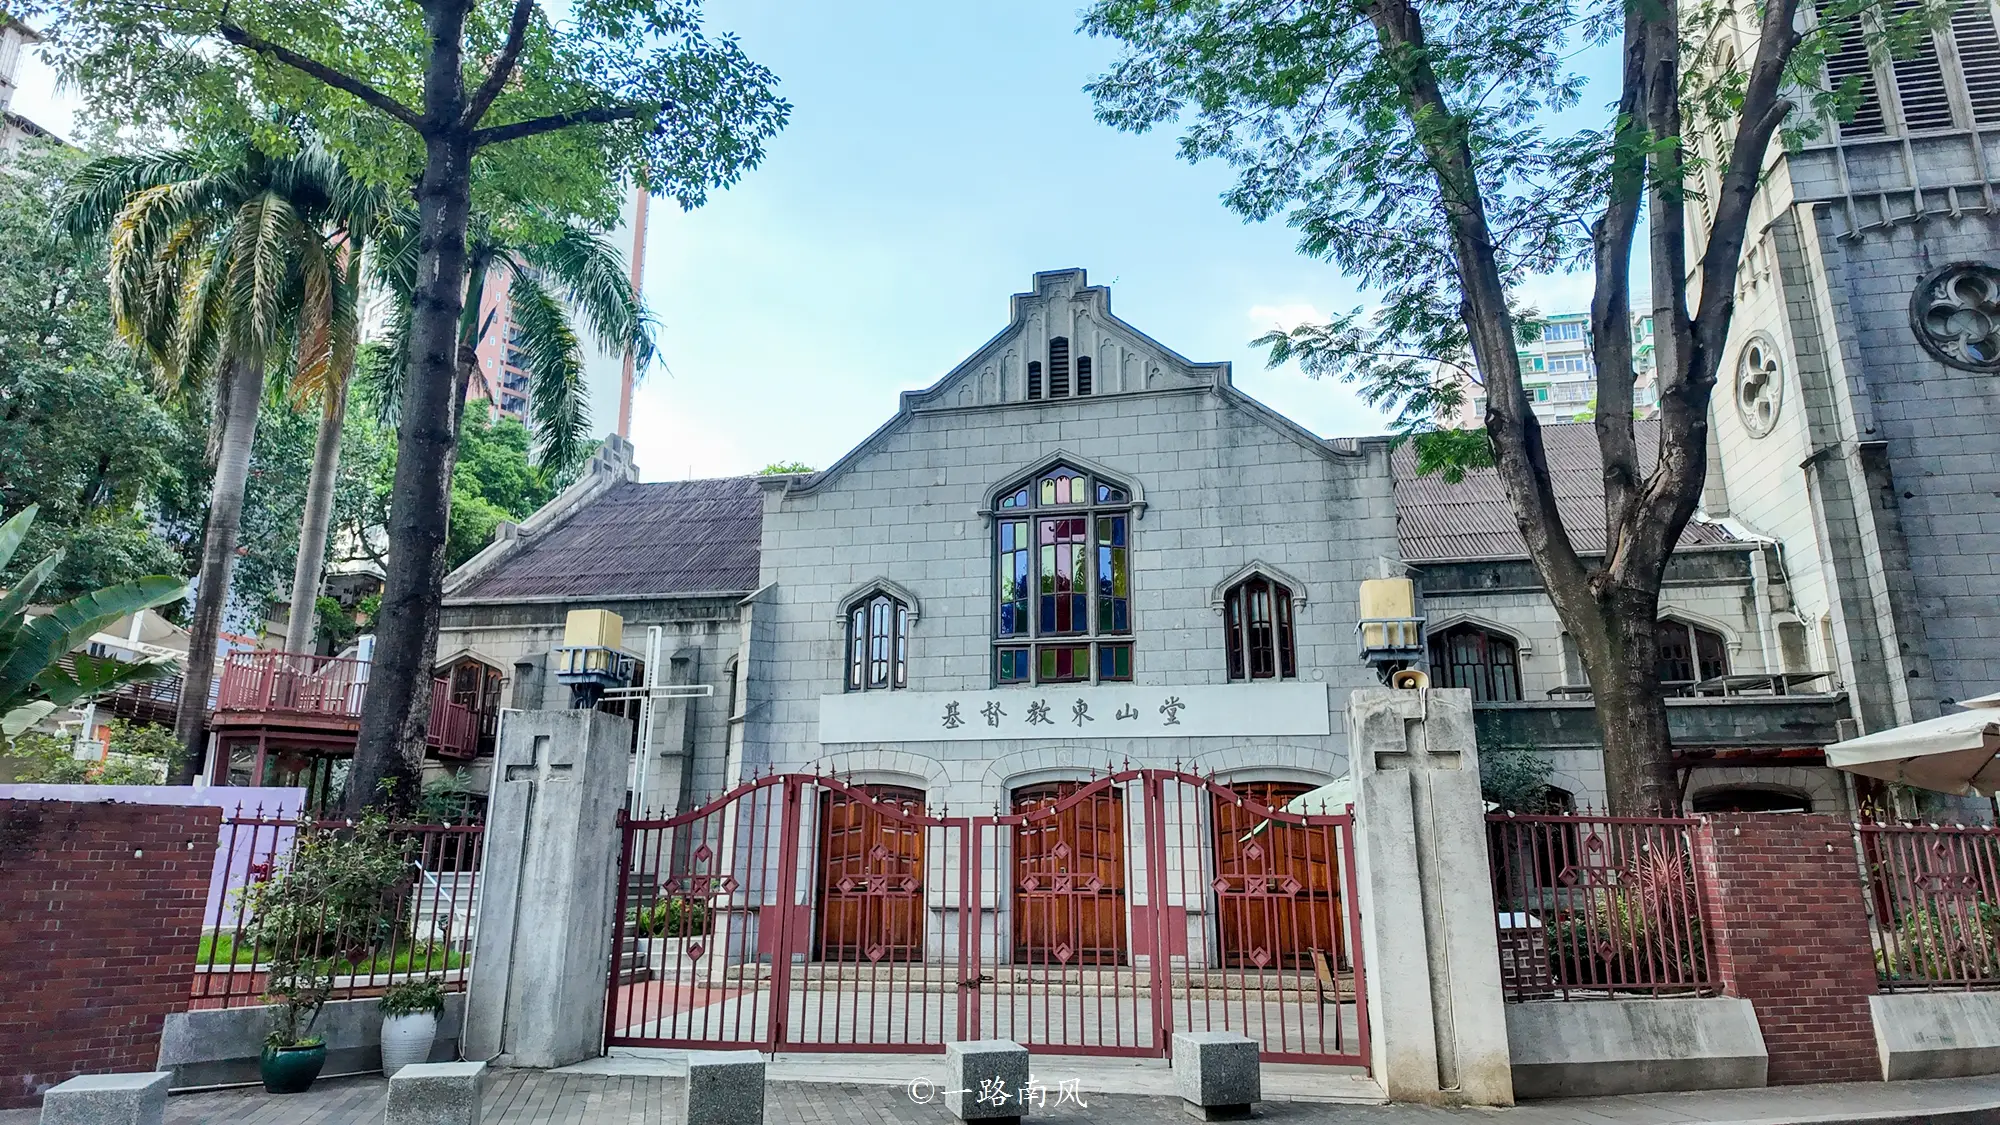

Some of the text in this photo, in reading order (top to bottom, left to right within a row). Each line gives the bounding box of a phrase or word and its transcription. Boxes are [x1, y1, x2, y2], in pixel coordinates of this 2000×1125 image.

[941, 696, 1186, 729] 基督教東山堂
